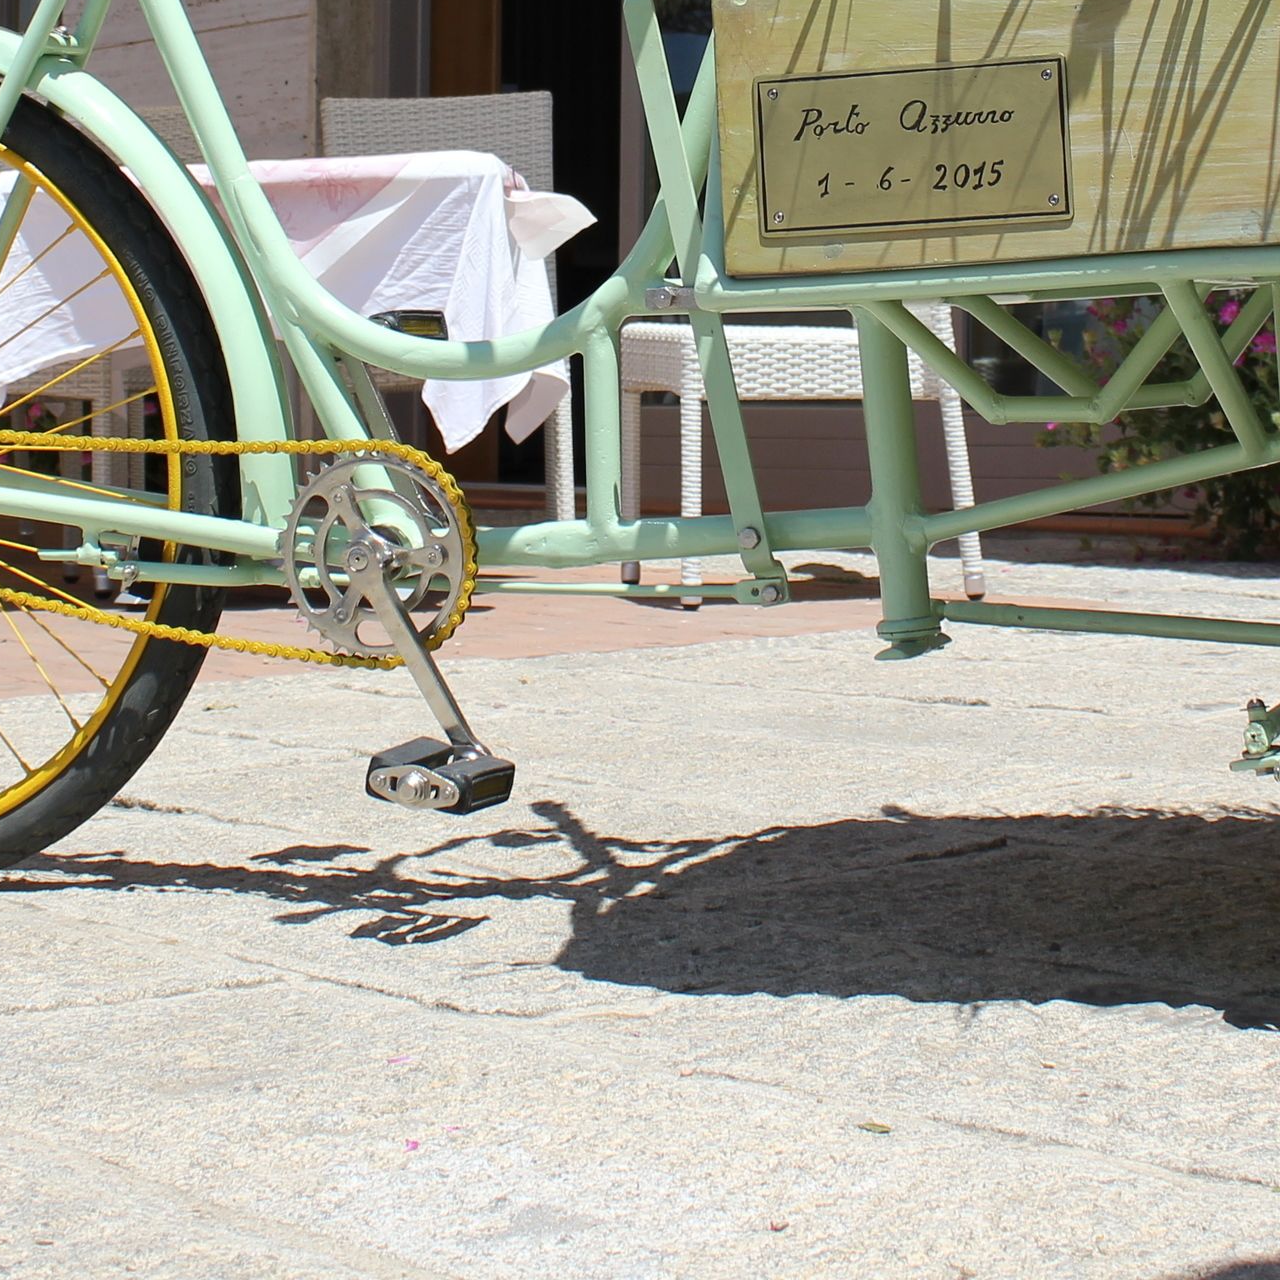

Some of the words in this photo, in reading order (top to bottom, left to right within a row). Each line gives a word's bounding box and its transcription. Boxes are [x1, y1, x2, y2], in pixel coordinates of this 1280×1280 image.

[793, 104, 870, 142] Porto
[899, 99, 1015, 135] Azzurro
[931, 159, 1005, 192] 2015
